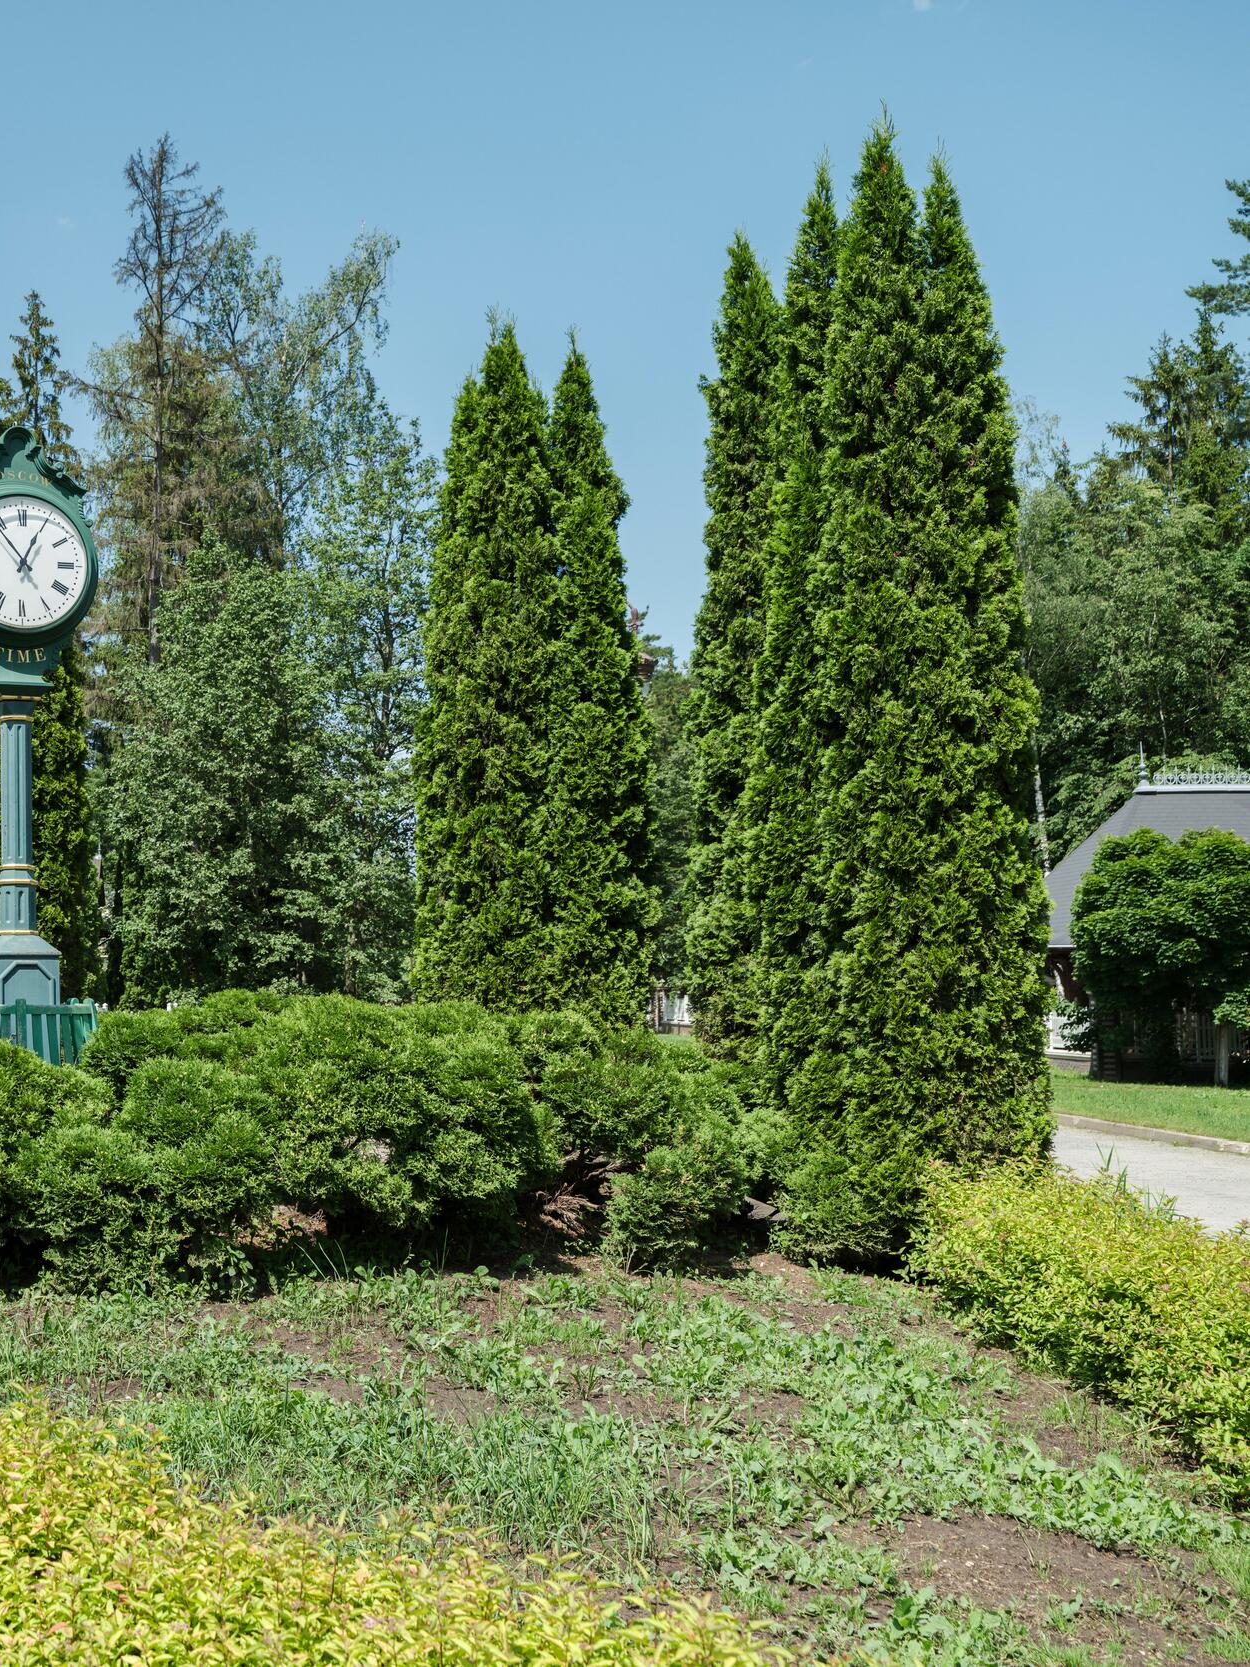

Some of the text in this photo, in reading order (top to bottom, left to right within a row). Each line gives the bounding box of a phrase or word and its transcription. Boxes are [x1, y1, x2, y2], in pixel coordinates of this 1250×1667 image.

[17, 509, 27, 527] XII
[52, 537, 68, 549] II
[57, 562, 74, 570] III
[18, 599, 26, 617] VI
